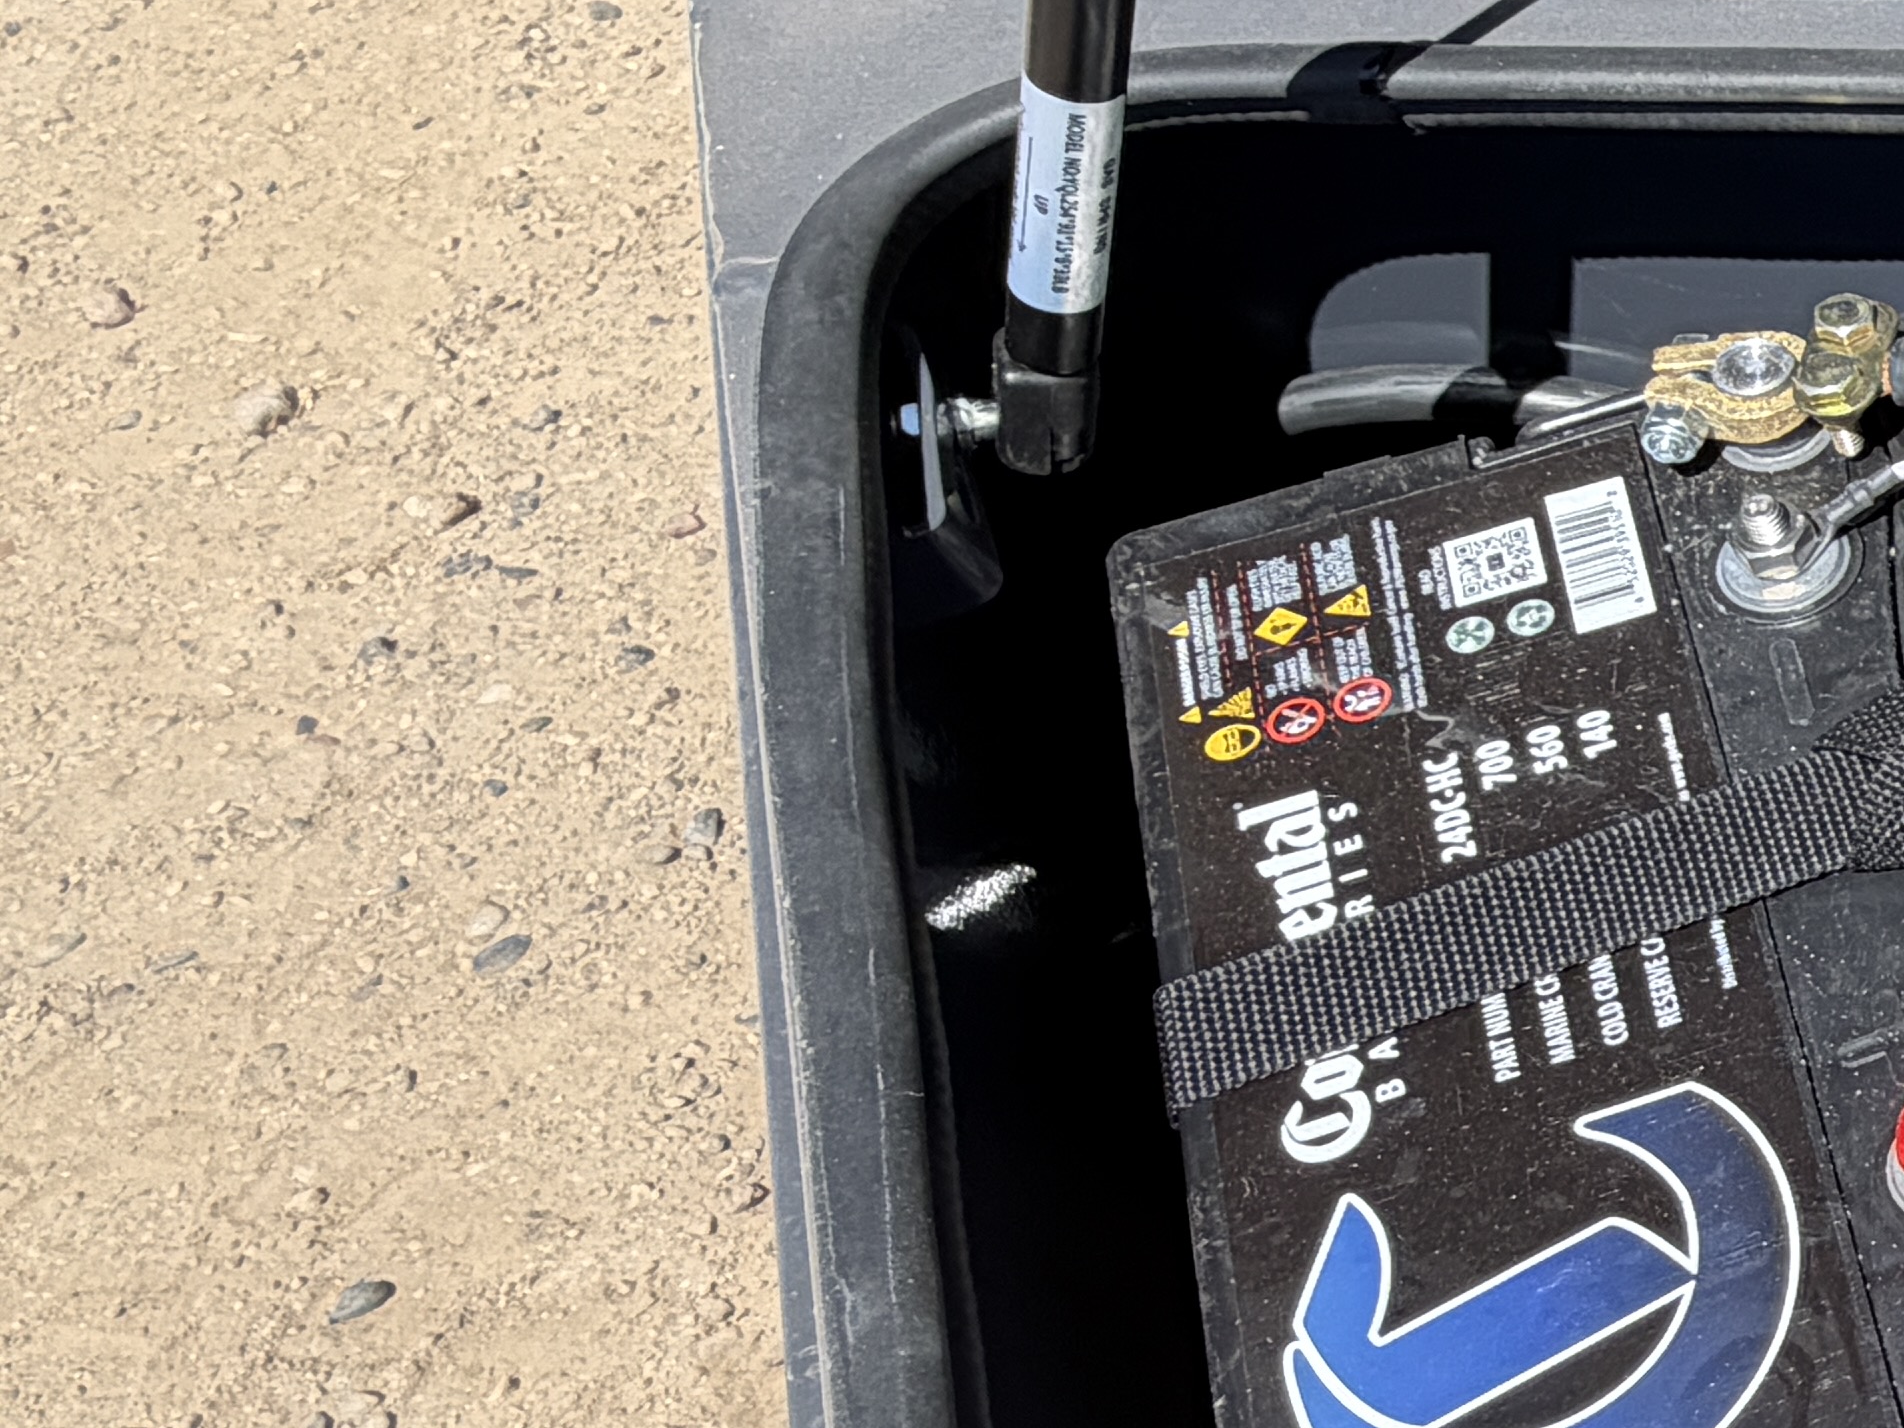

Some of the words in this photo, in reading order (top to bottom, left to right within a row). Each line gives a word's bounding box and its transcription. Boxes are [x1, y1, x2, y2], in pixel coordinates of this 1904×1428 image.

[1064, 113, 1086, 153] MODEL
[1034, 194, 1048, 215] UP
[1526, 724, 1568, 774] 560
[1577, 710, 1617, 759] 140
[1476, 739, 1517, 790] 700
[1646, 960, 1682, 1027] RESERVE
[1540, 995, 1576, 1064] MARINE
[1597, 1002, 1629, 1045] COLD
[1489, 1036, 1521, 1082] PART
